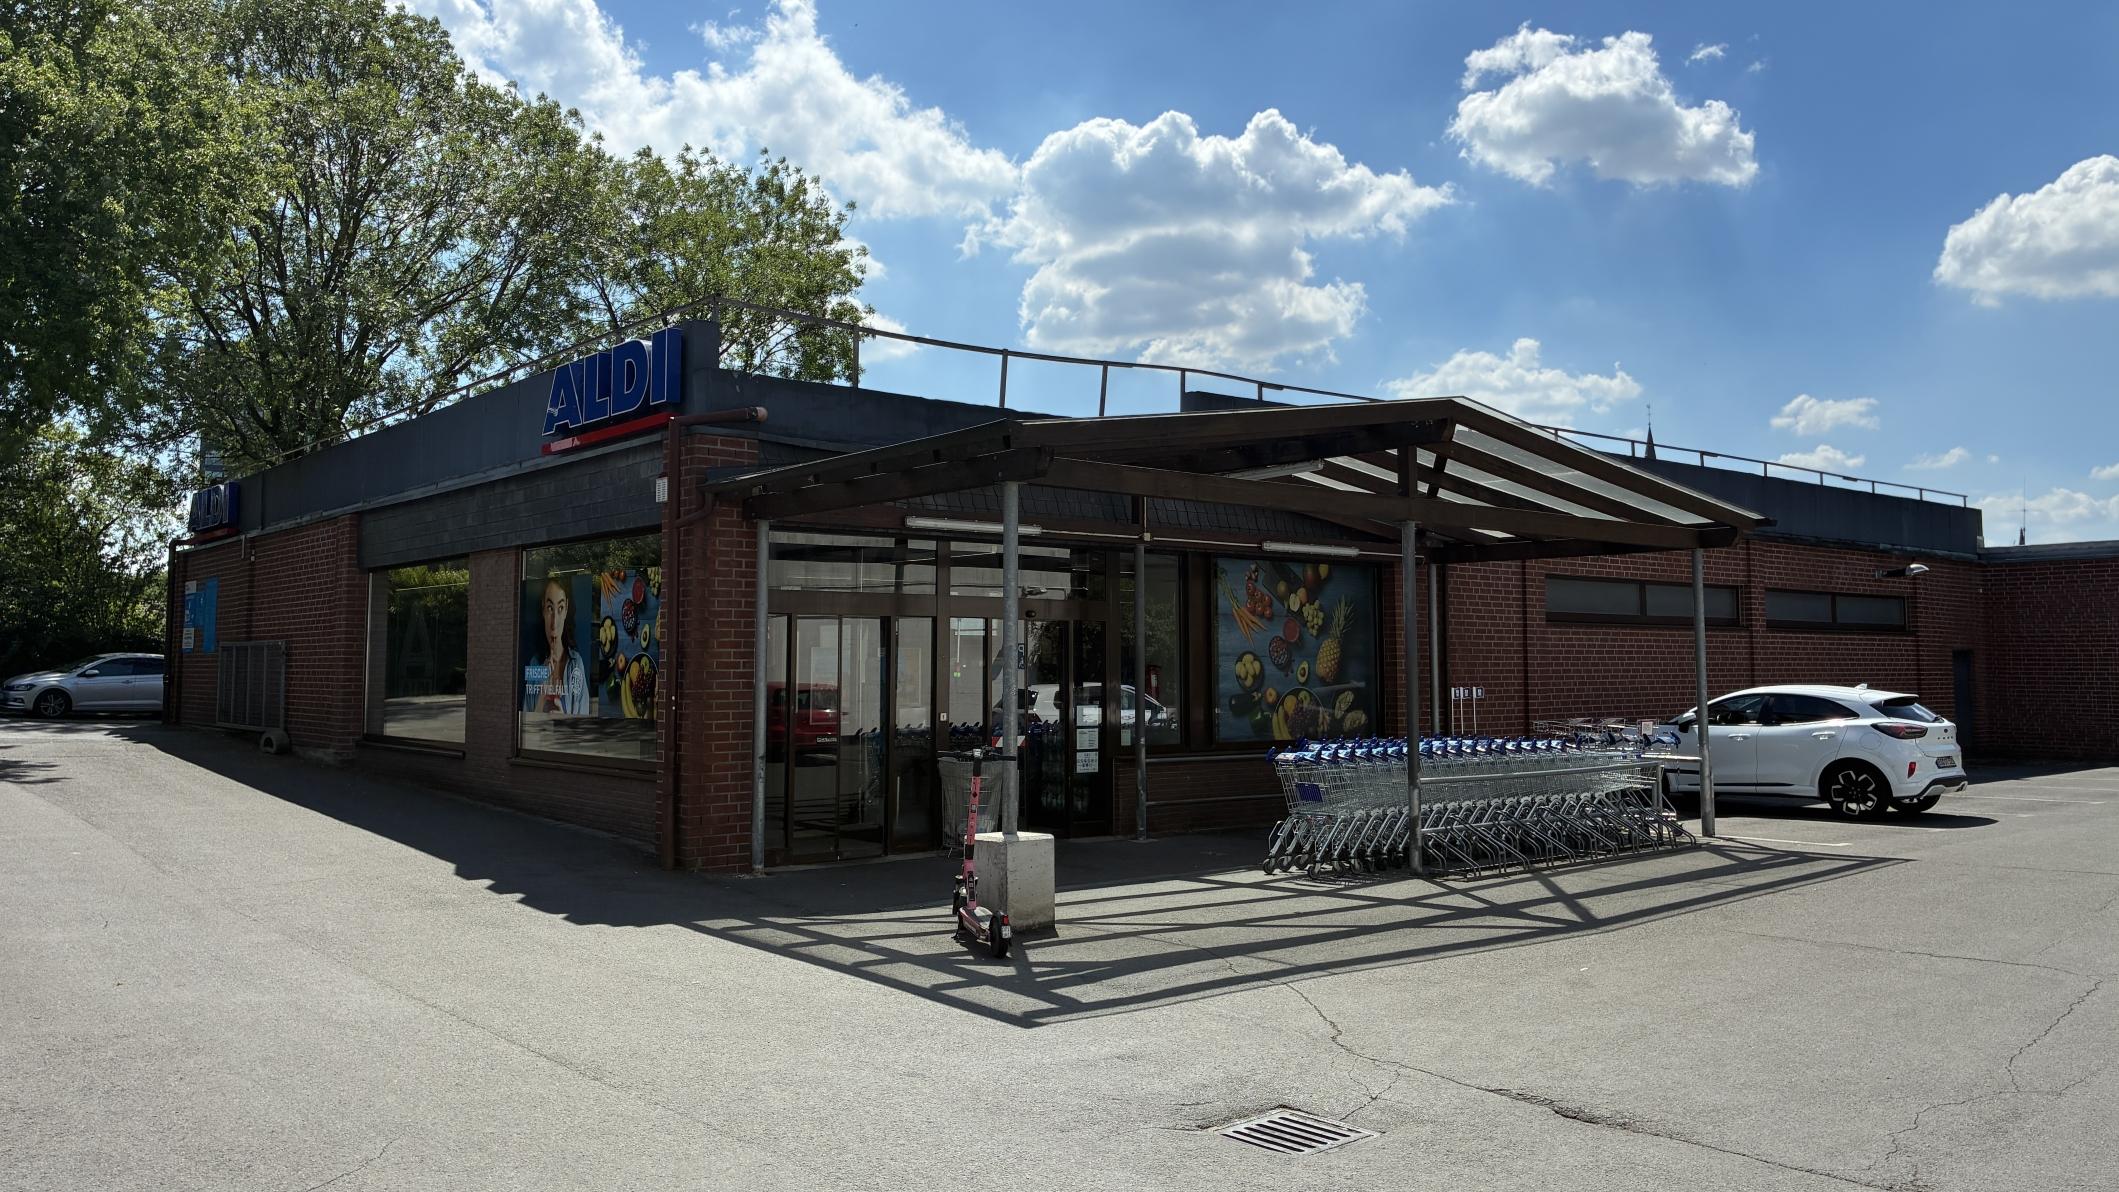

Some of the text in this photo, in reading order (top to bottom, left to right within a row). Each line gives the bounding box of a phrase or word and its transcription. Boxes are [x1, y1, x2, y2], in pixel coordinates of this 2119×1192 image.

[542, 328, 670, 436] ALDI
[190, 482, 230, 530] ALDI
[526, 667, 548, 679] FRISCHE
